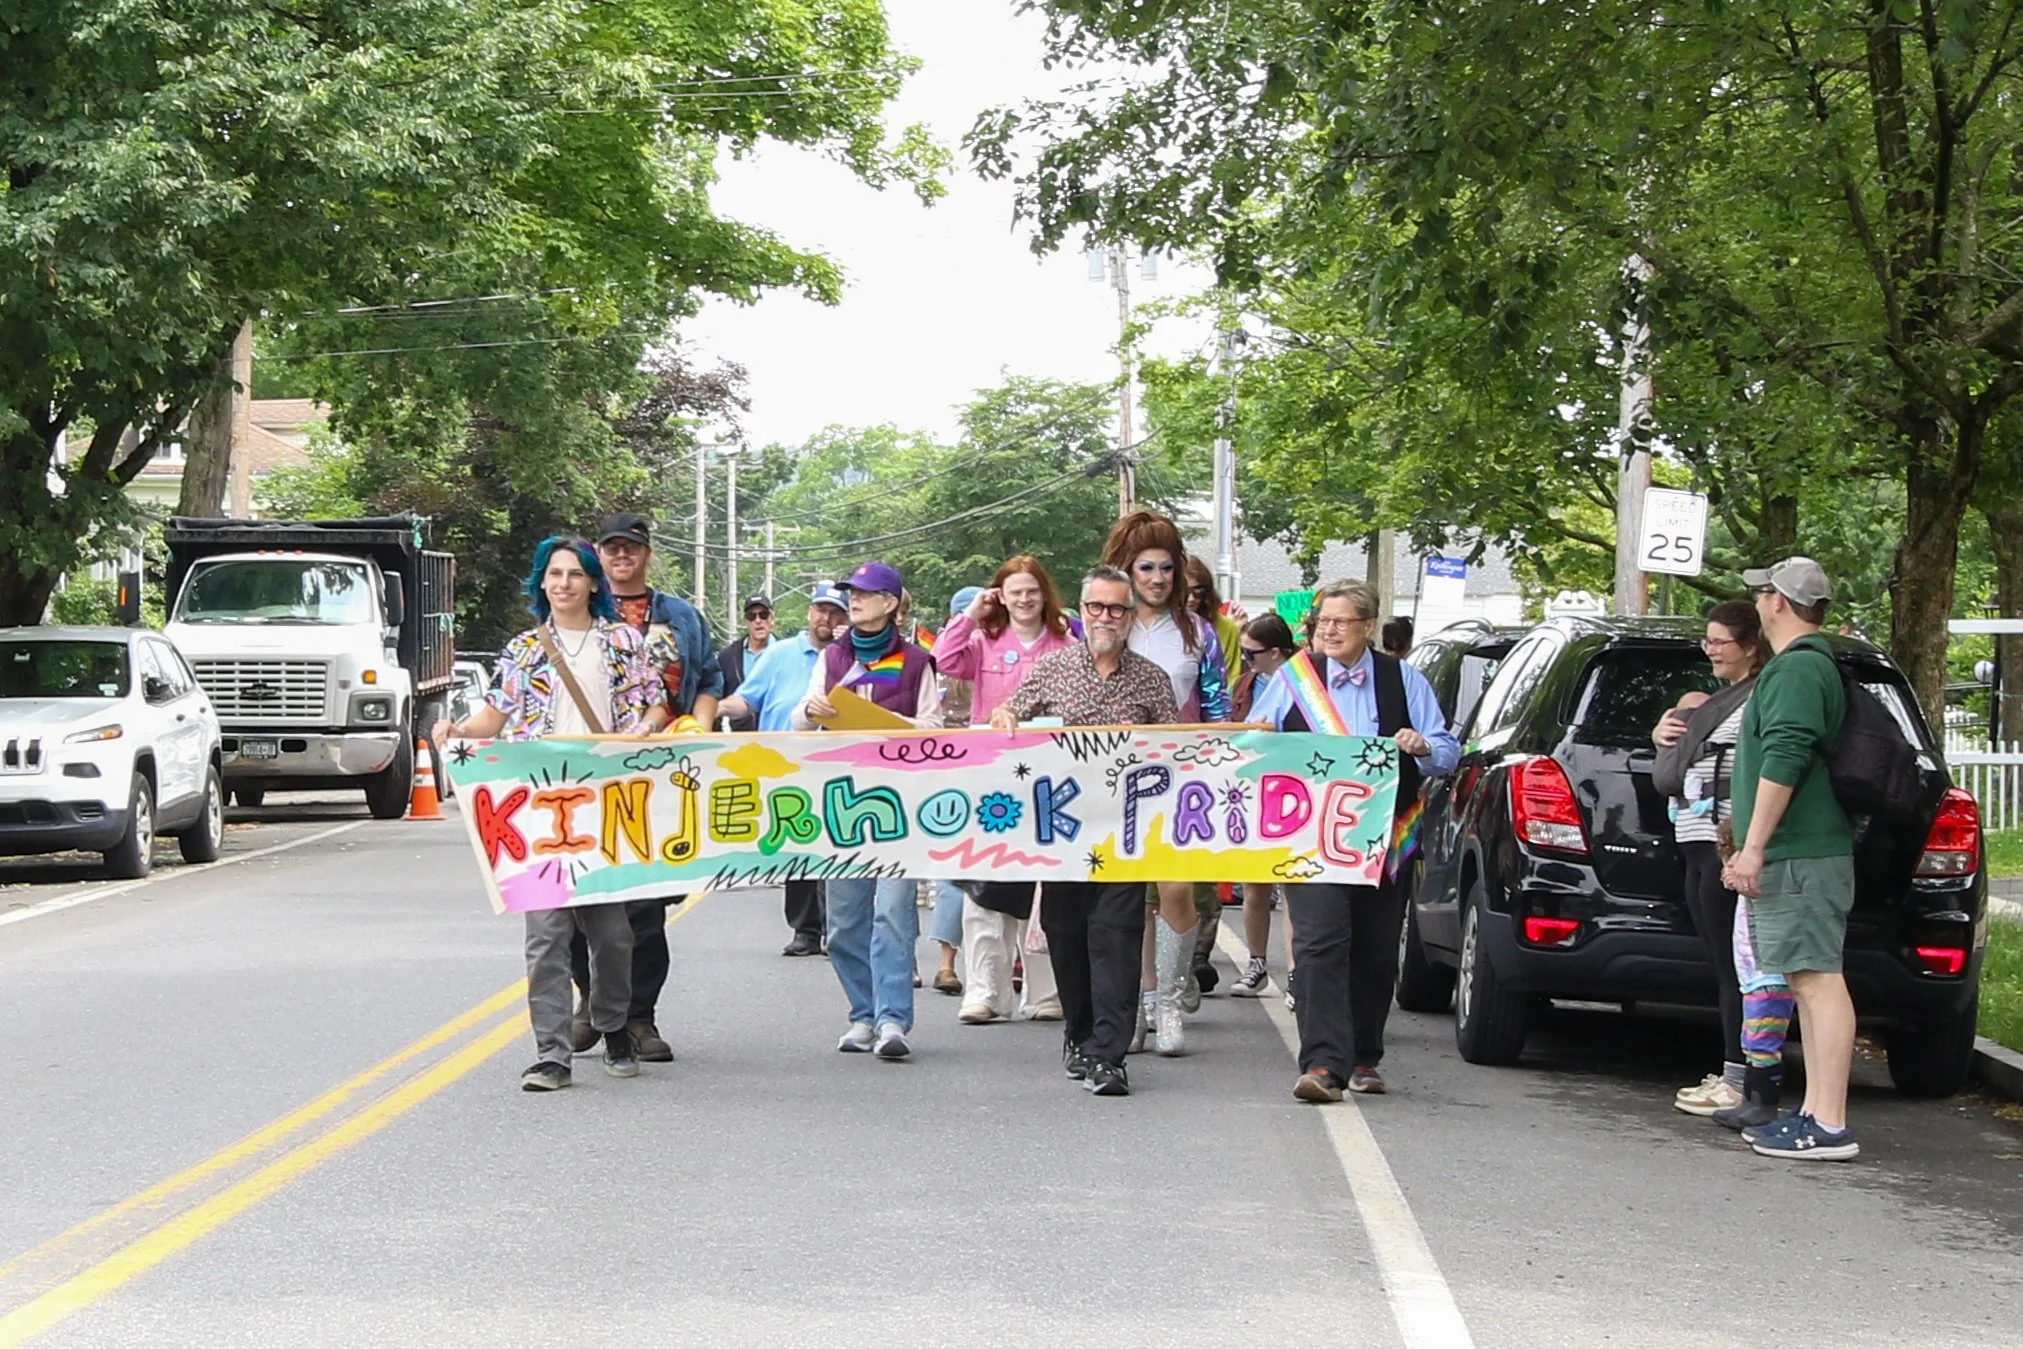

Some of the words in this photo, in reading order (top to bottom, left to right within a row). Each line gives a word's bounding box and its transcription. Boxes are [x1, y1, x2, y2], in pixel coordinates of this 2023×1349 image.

[1654, 498, 1697, 514] SPEED
[1656, 516, 1691, 529] LIMIT
[1647, 533, 1693, 563] 25
